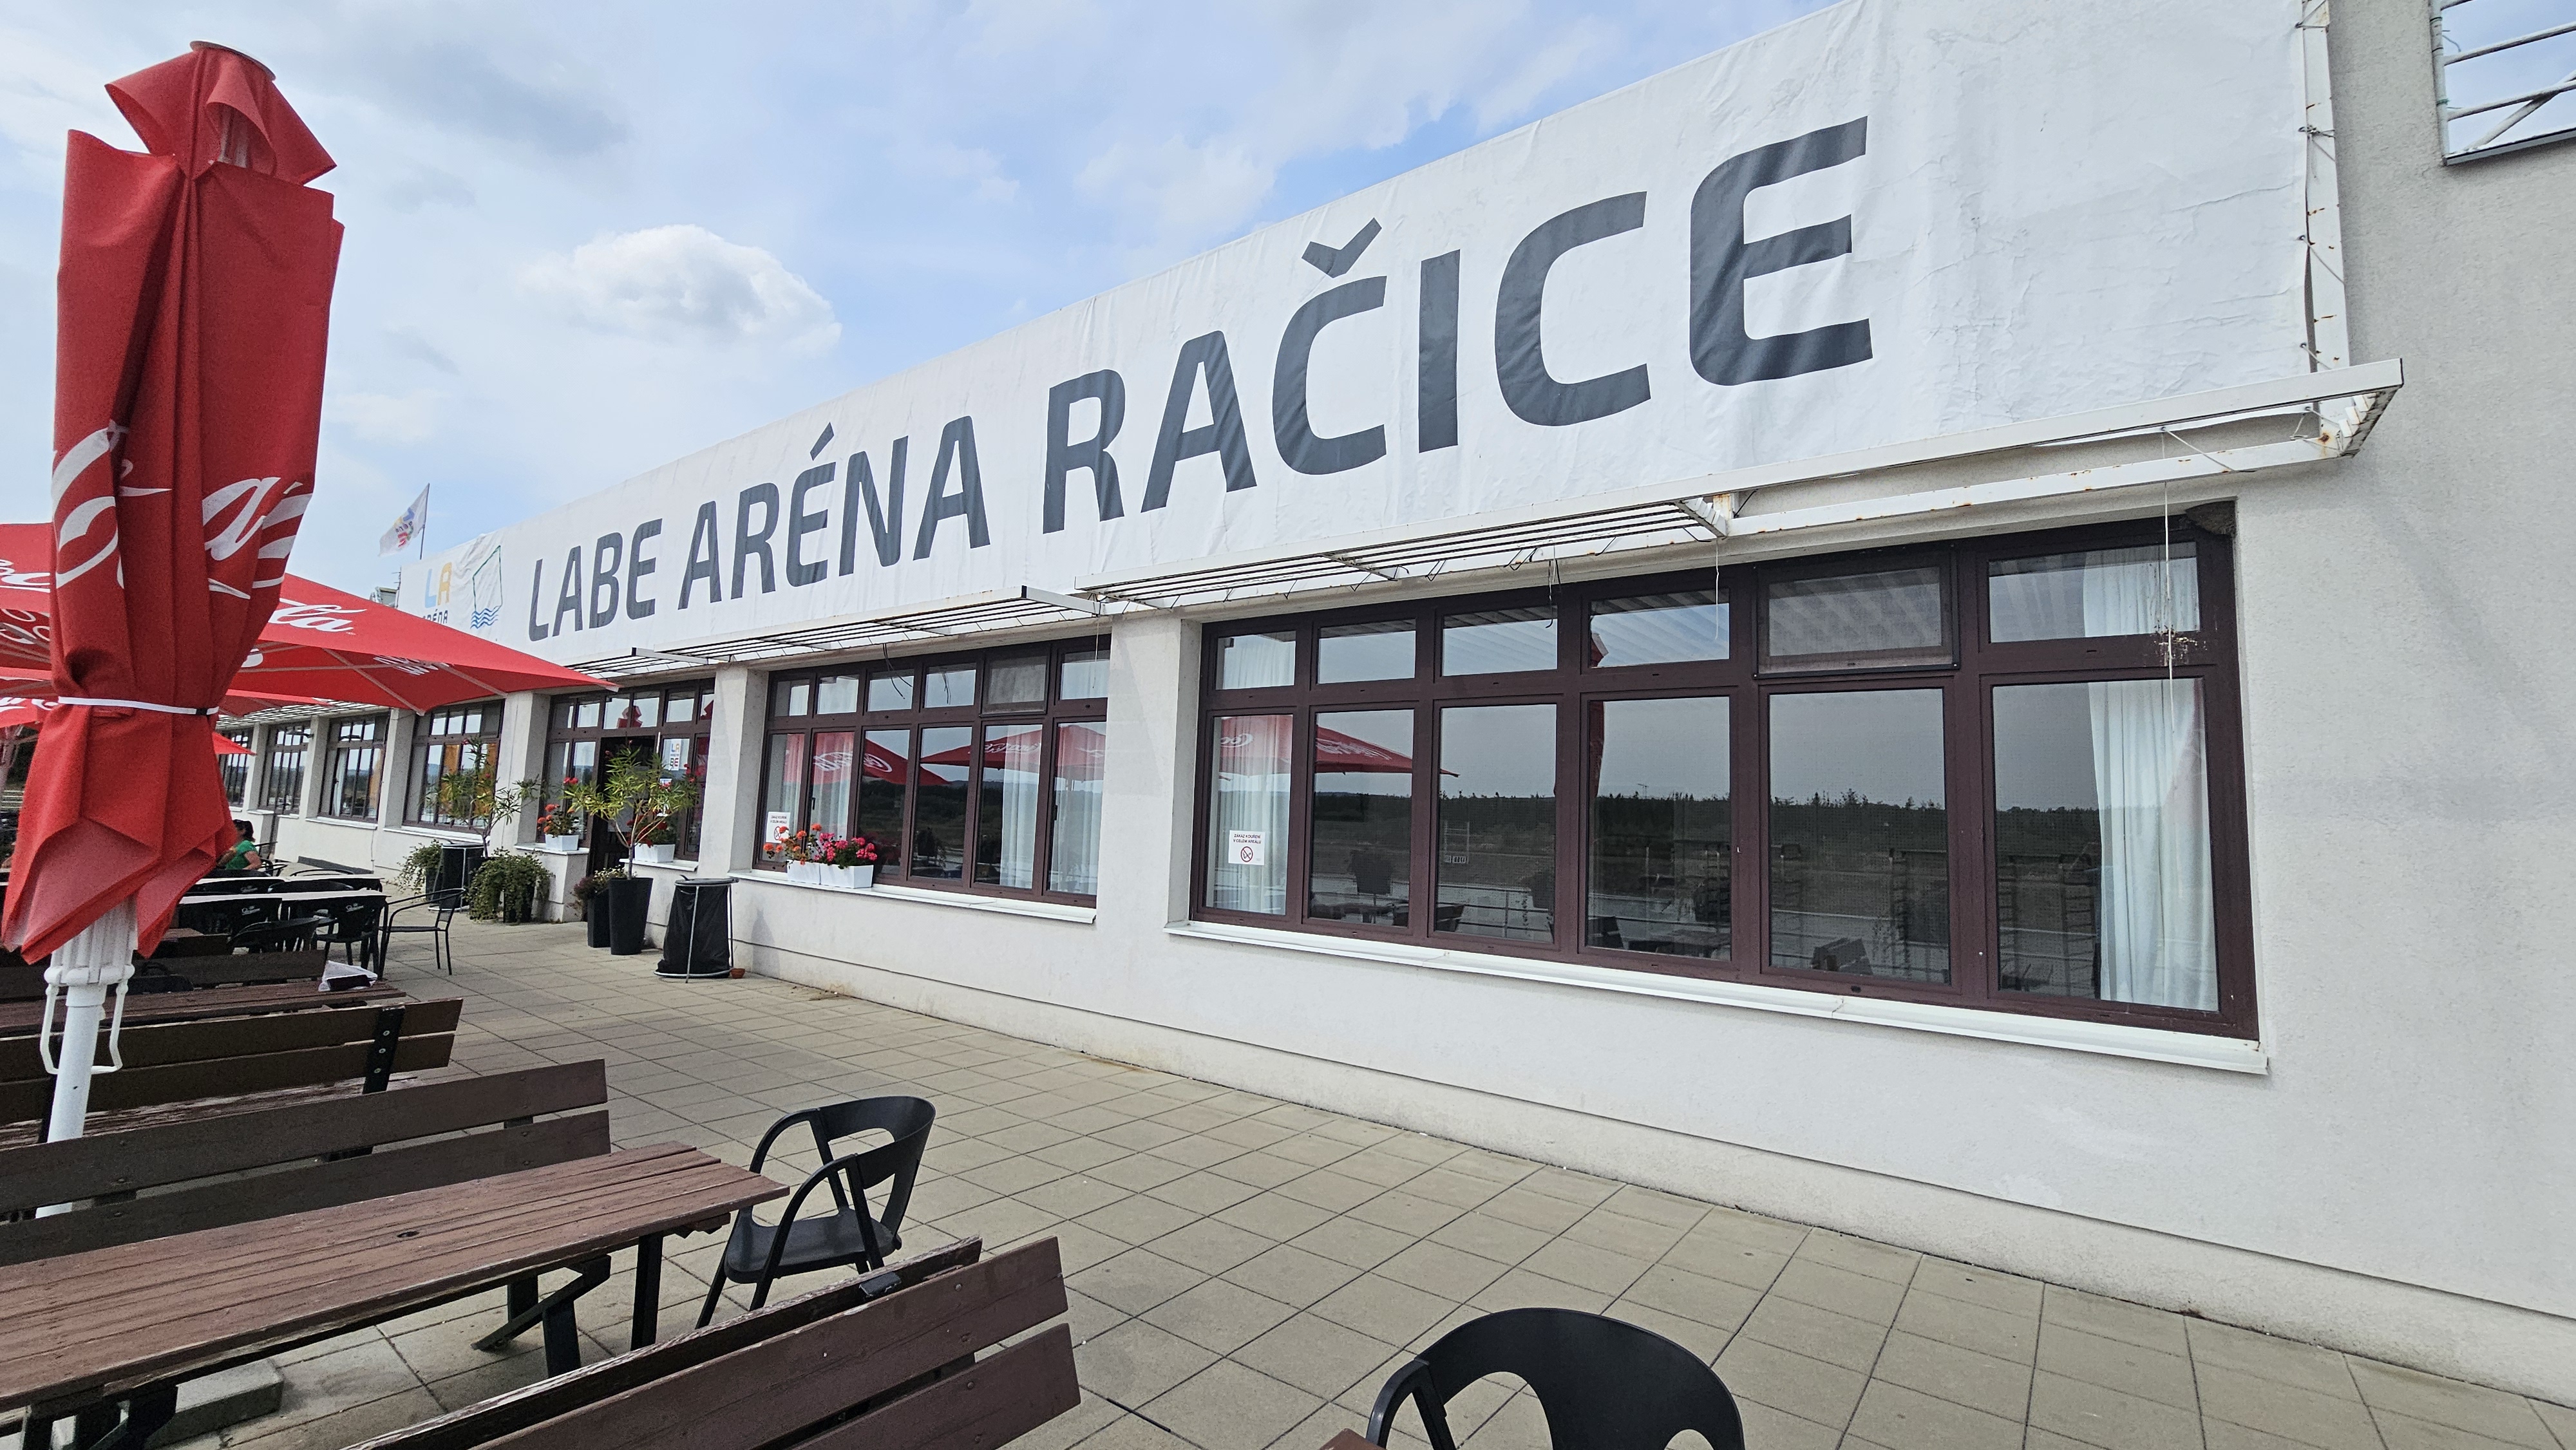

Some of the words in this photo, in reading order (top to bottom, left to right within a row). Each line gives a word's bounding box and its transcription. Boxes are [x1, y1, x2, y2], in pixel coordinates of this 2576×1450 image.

[528, 518, 663, 642] LABE
[677, 415, 991, 610] ARÉNA
[1042, 115, 1873, 534] RAČICE
[424, 562, 452, 608] LA
